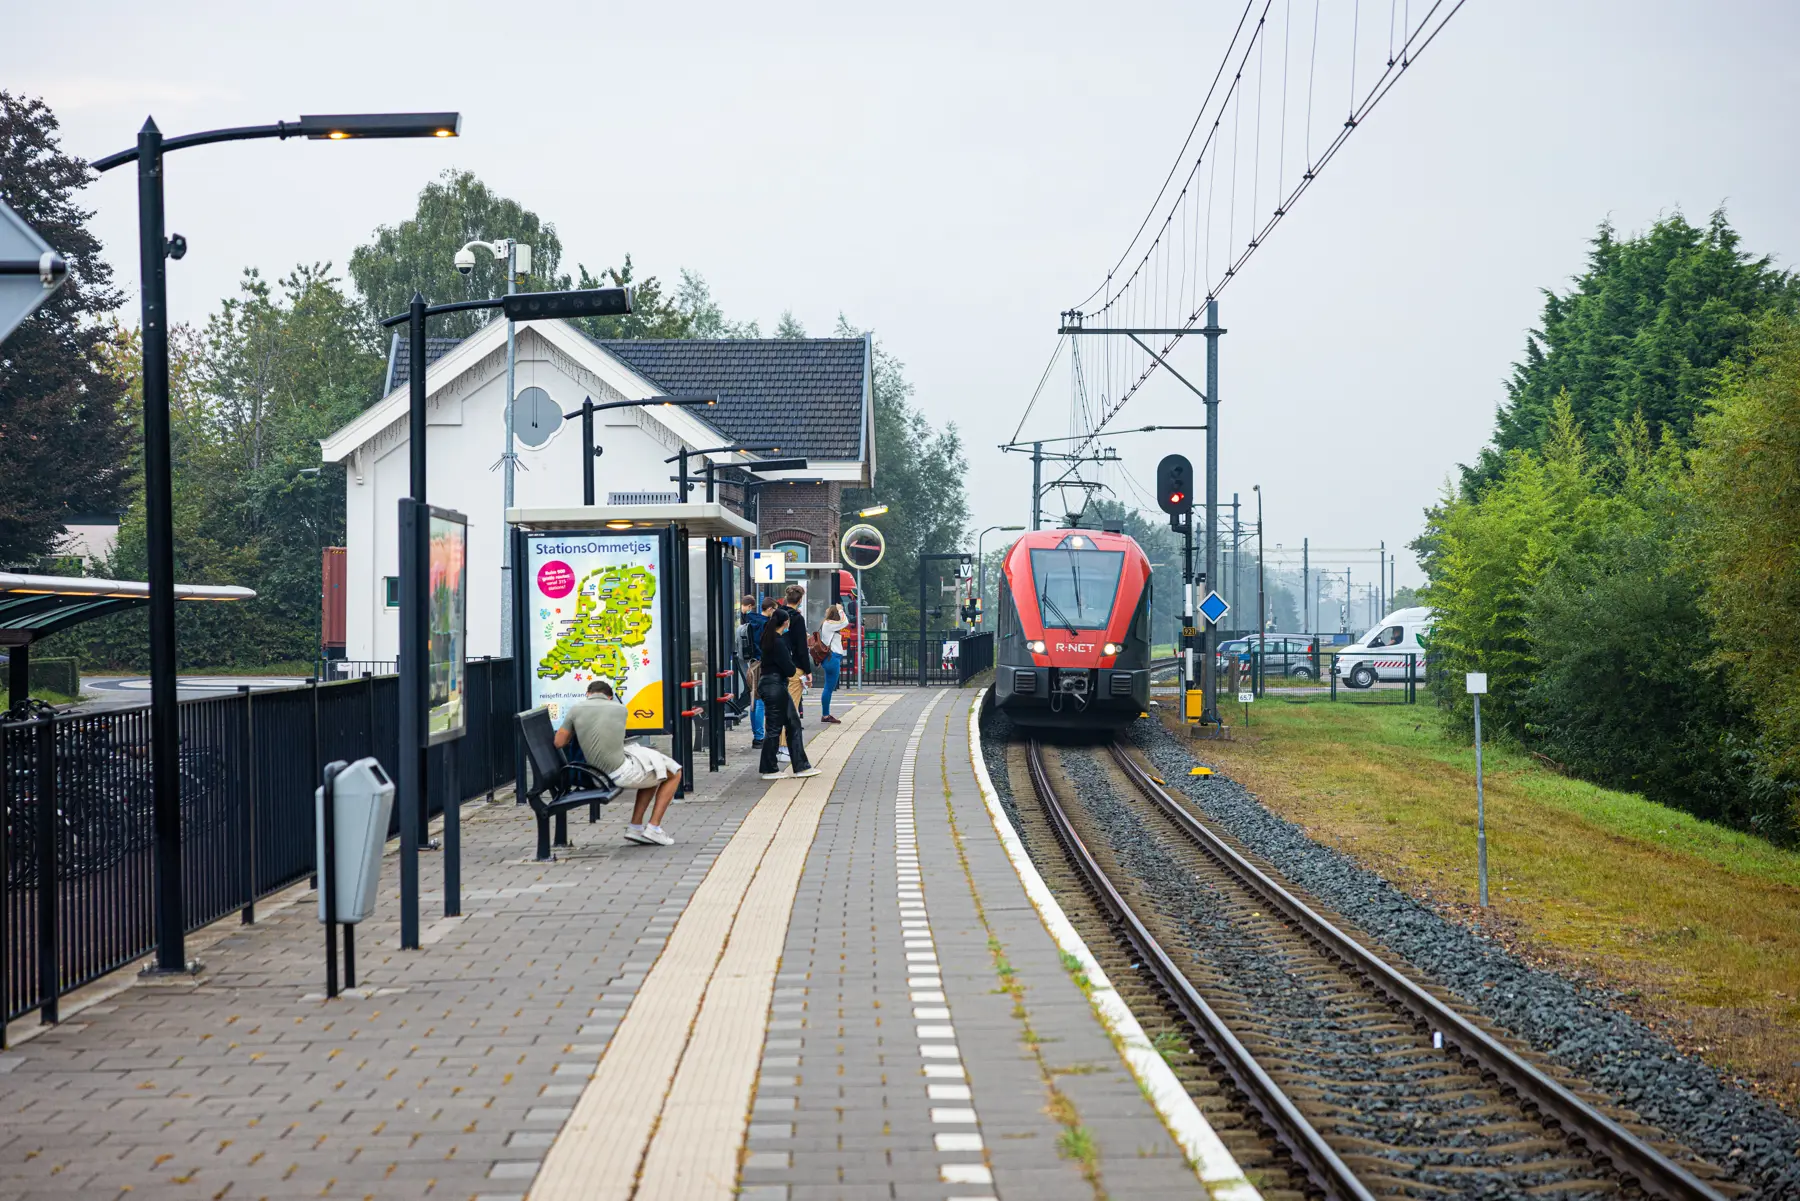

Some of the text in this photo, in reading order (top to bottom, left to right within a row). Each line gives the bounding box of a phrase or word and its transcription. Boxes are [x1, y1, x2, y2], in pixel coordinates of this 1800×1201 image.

[536, 541, 651, 554] StationsOmmetjes
[765, 564, 772, 580] 1
[961, 565, 970, 576] V
